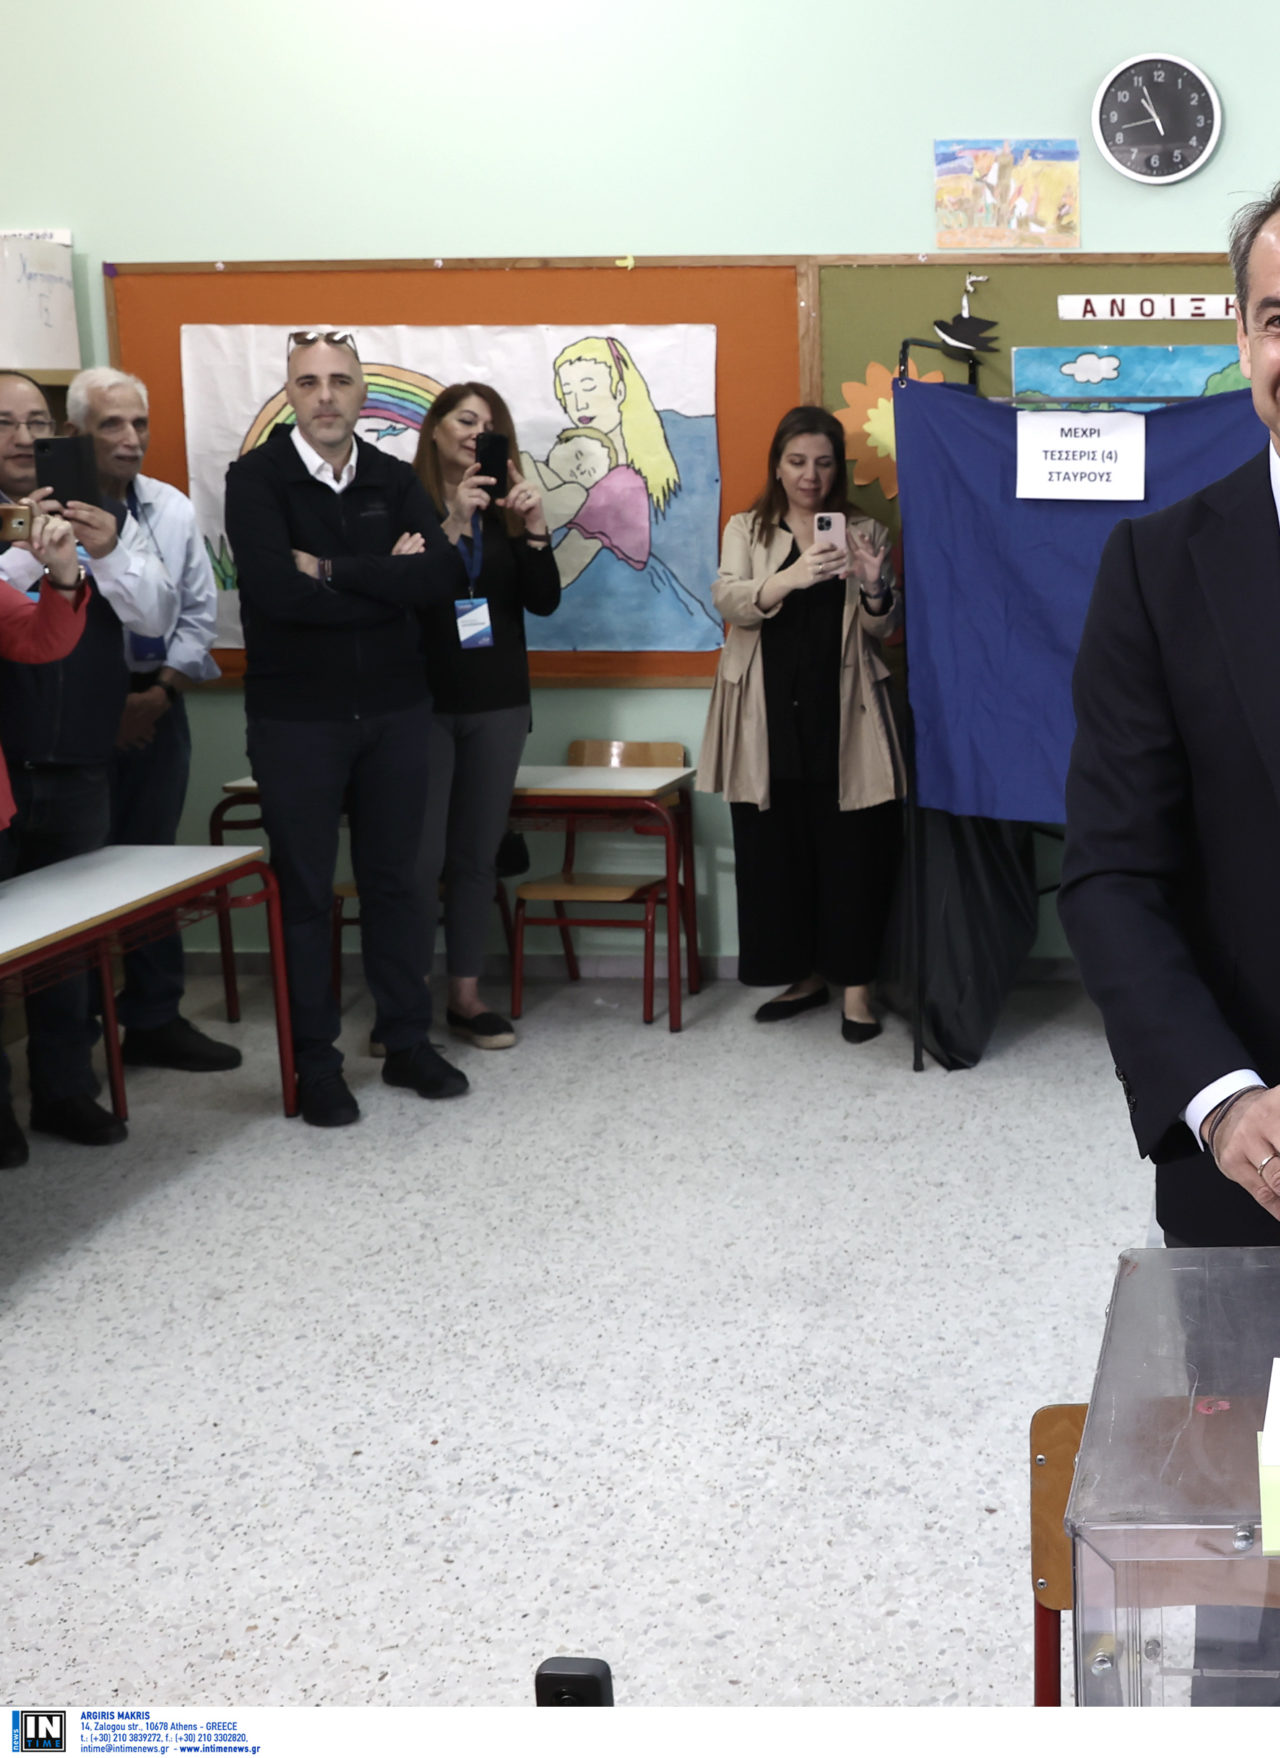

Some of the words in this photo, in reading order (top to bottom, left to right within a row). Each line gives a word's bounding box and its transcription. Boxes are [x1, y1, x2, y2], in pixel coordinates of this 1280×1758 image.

[1133, 76, 1143, 87] 11
[1153, 70, 1165, 82] 12
[1177, 78, 1182, 90] 1
[1117, 91, 1129, 102] 10
[1190, 93, 1199, 106] 2
[1109, 111, 1118, 123] 9
[1196, 115, 1205, 127] 3
[1115, 132, 1124, 144] 8
[1188, 136, 1197, 147] 4
[1130, 148, 1138, 160] 7
[1172, 150, 1182, 162] 5
[1150, 155, 1160, 167] 6
[1060, 427, 1101, 438] ΜΕΧΡΙ
[1042, 450, 1098, 461] ΤΕΣΣΕΡΙΣ
[1101, 450, 1118, 463] (4)
[1048, 471, 1113, 482] ΣΤΑΥΡΟΥΣ
